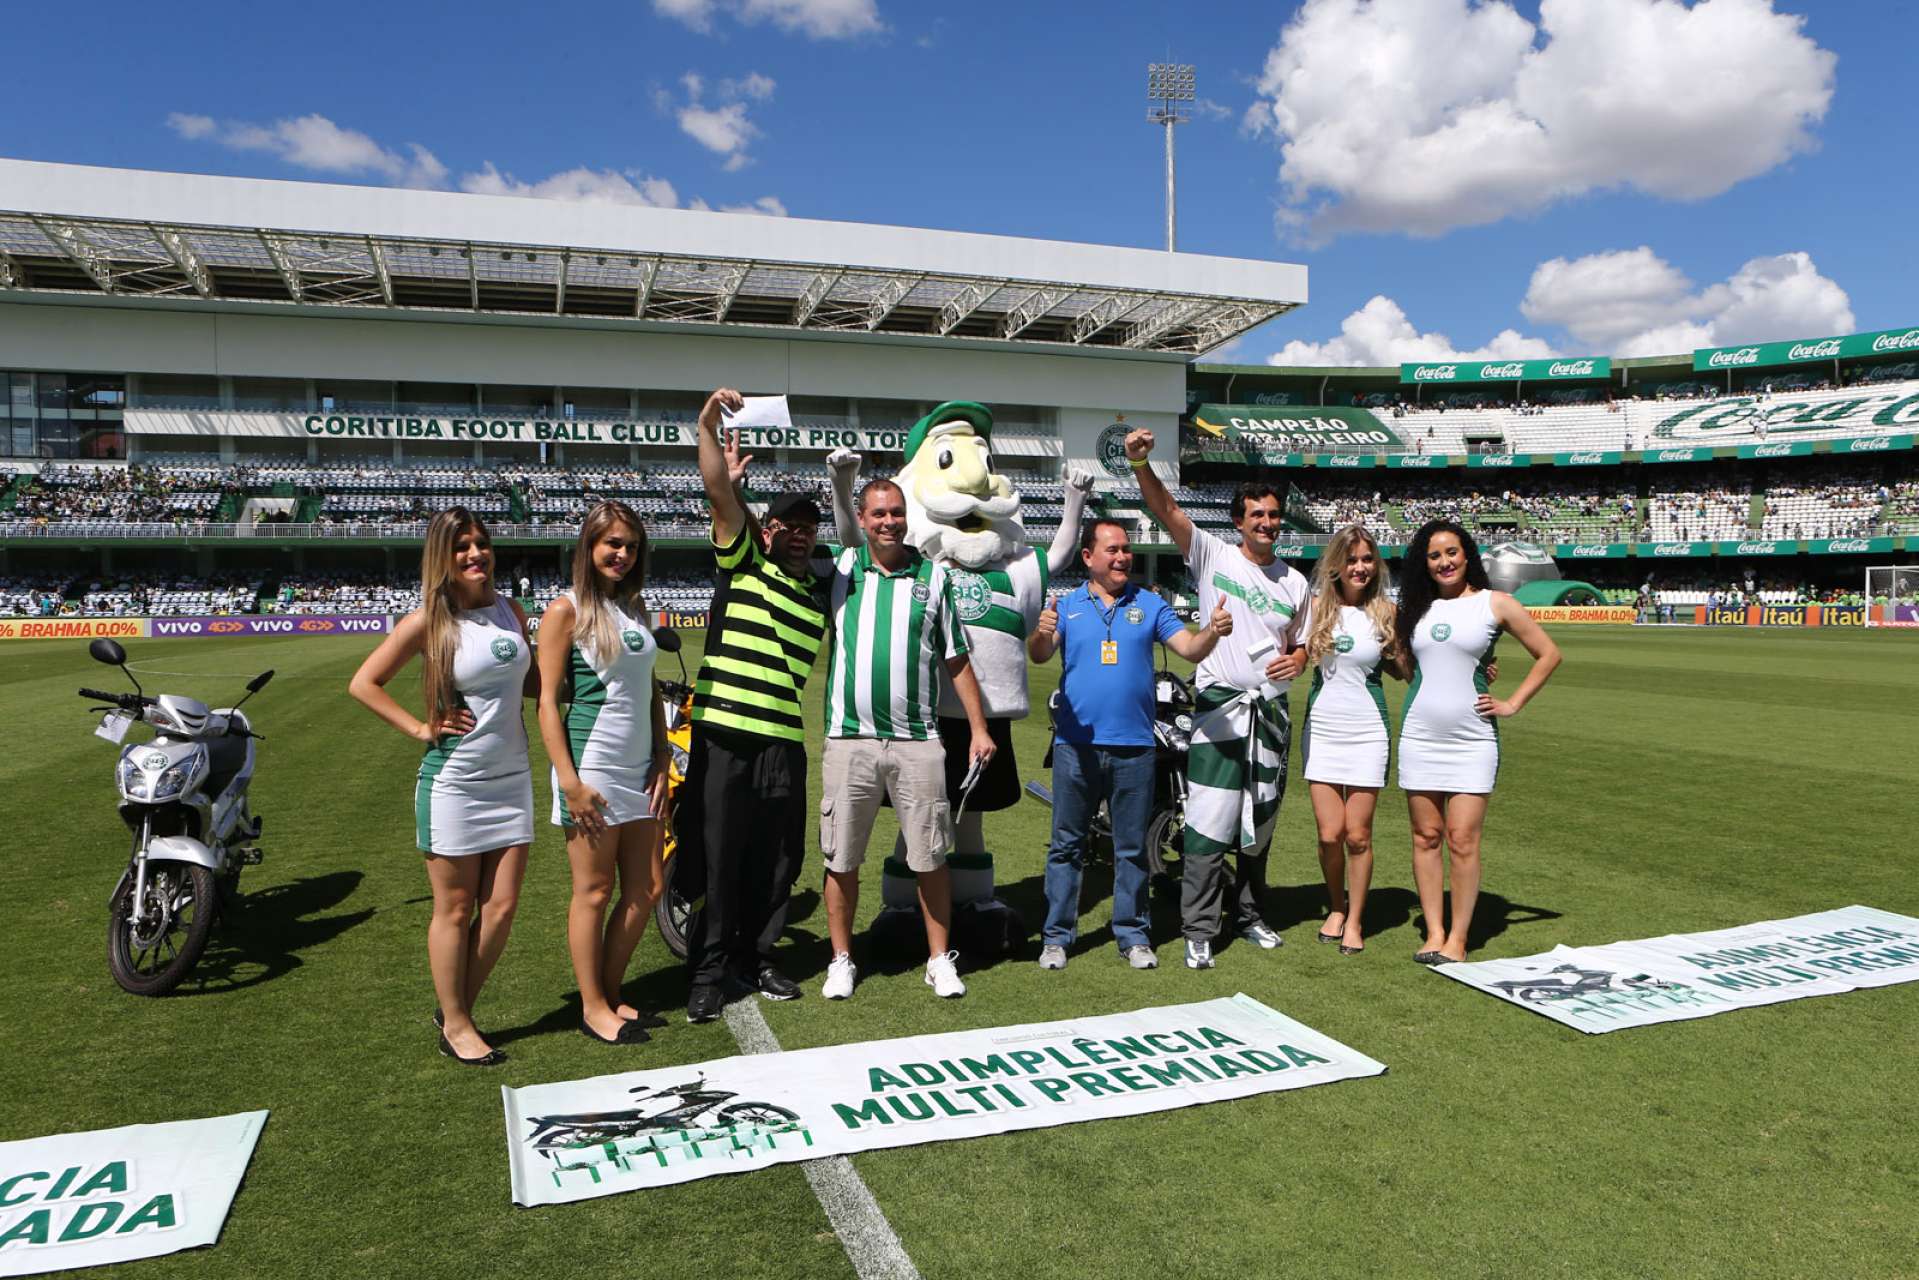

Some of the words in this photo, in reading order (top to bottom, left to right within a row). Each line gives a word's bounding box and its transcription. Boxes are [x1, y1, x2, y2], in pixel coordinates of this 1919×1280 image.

[305, 416, 443, 438] CORITIBA
[452, 418, 526, 440] FOOT
[534, 420, 602, 442] BALL
[611, 423, 680, 443] CLUB
[1230, 416, 1349, 432] CAMPEÃO
[809, 429, 857, 448] PRO
[669, 613, 705, 628] Itaú
[1569, 608, 1609, 621] BRAHMA
[1708, 607, 1745, 624] Itaú
[1763, 607, 1802, 625] Itaú
[1823, 606, 1865, 625] Itaú
[20, 623, 92, 637] BRAHMA
[95, 622, 138, 636] 0,0%
[1697, 963, 1830, 991] MULTI
[870, 1025, 1246, 1092] ADIMPLÊNCIA
[831, 1083, 1026, 1129] MULTI
[1029, 1043, 1330, 1102] PREMIADA
